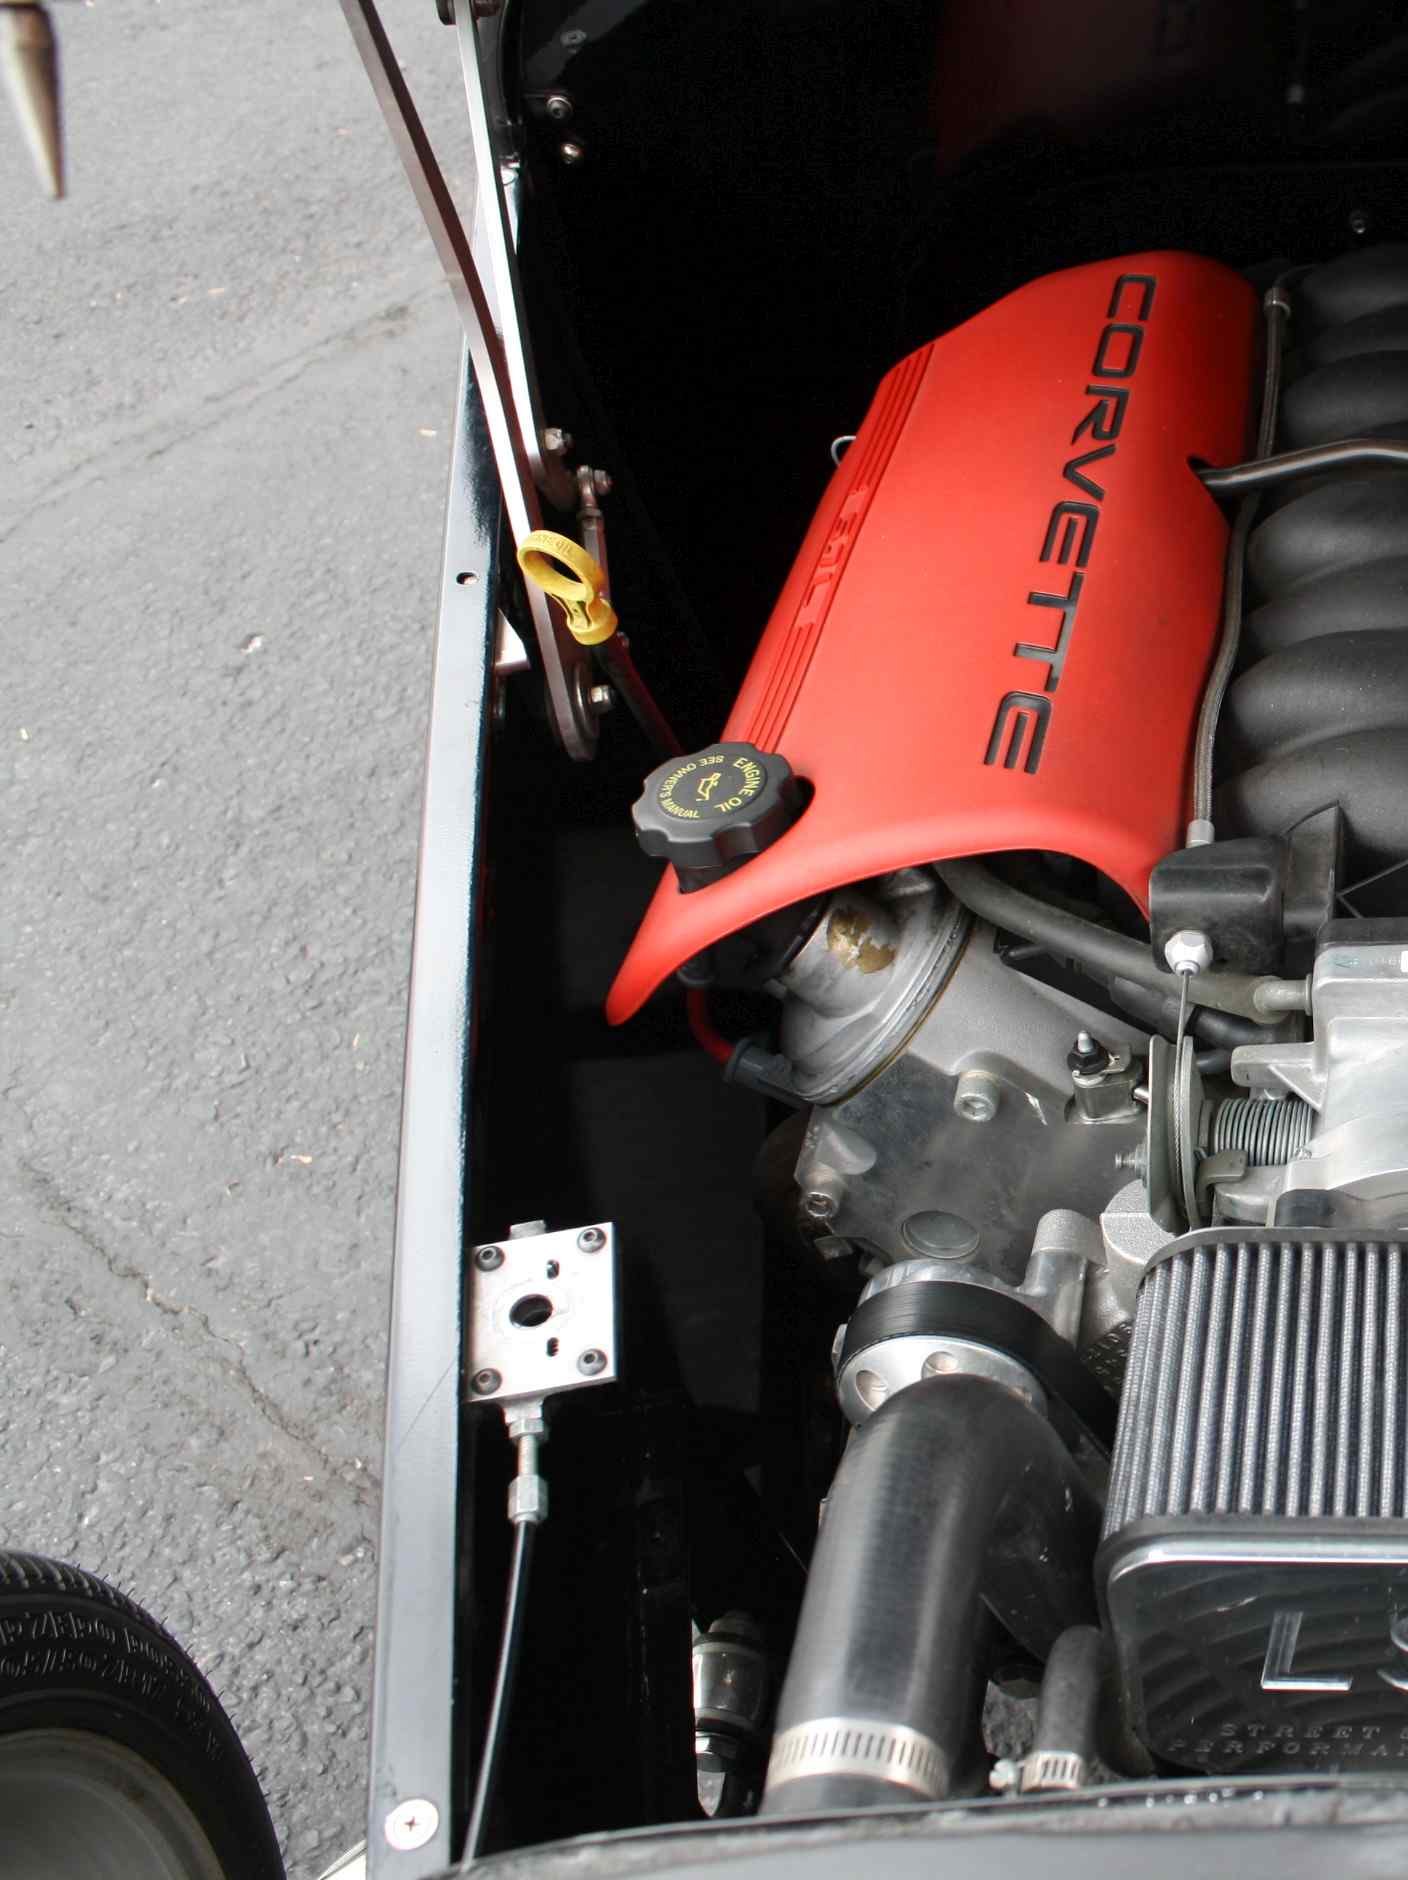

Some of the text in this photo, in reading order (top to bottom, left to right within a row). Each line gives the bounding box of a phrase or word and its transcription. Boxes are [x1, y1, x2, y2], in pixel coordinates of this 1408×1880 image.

[984, 274, 1157, 775] CORVETTE
[698, 755, 725, 767] SEE
[713, 757, 760, 812] ENGINE OIL
[661, 799, 700, 818] MANUAL
[1220, 1723, 1380, 1739] STREET
